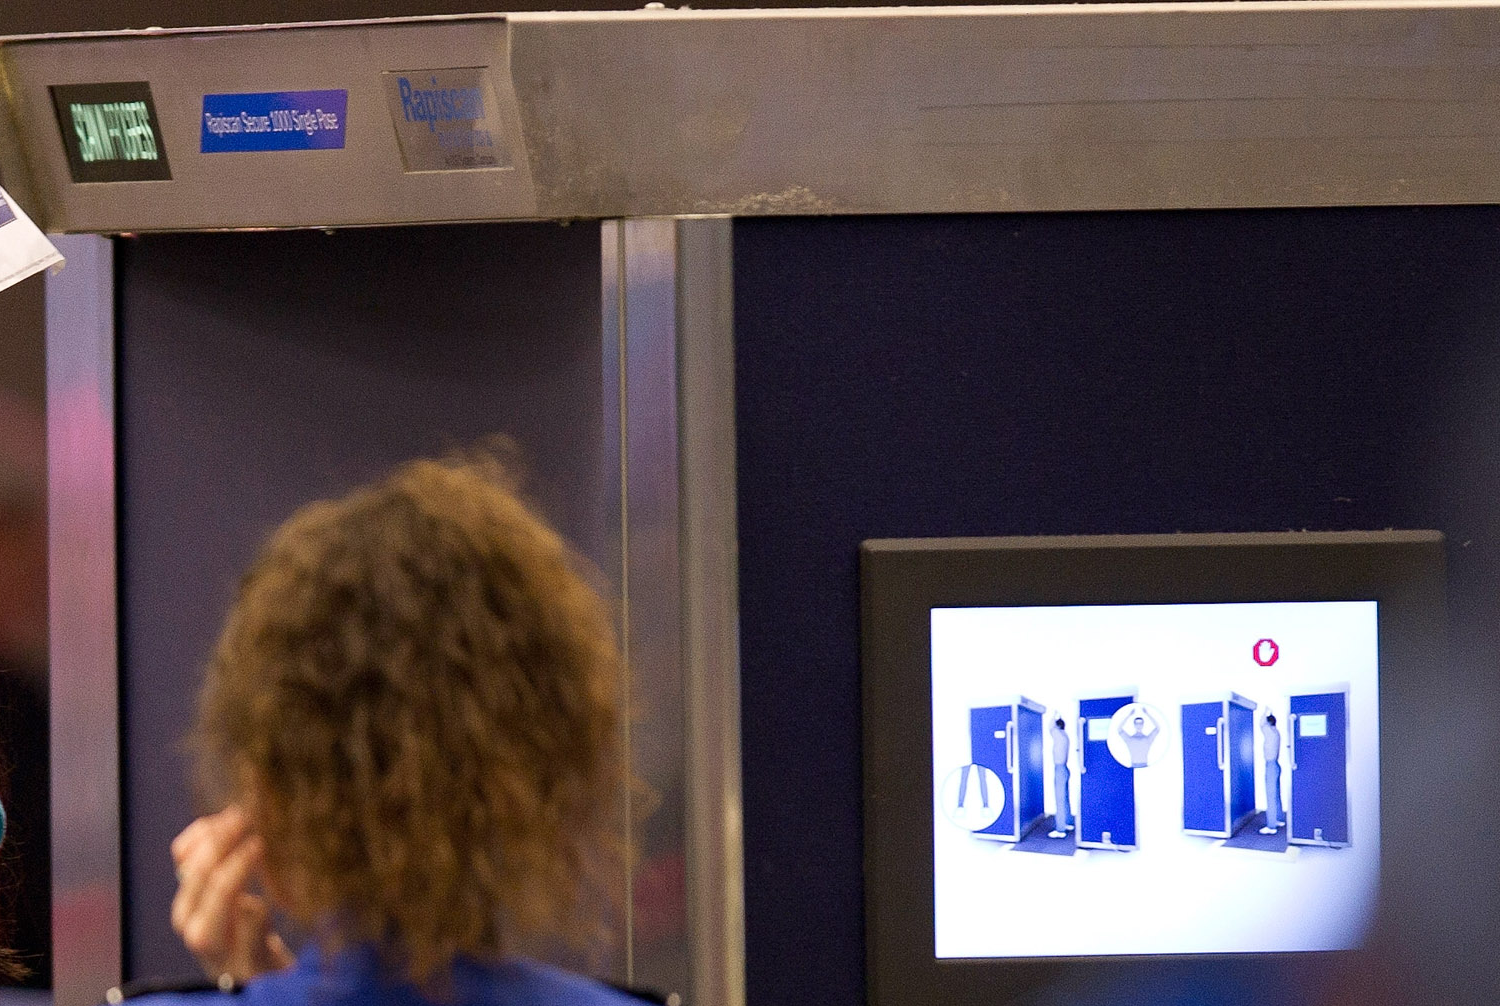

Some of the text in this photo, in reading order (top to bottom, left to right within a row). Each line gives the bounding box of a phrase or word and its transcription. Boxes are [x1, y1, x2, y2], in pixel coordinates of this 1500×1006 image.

[204, 108, 339, 138] Rapiscan Secure 1000 Single Pose
[398, 76, 485, 132] Rapiscan
